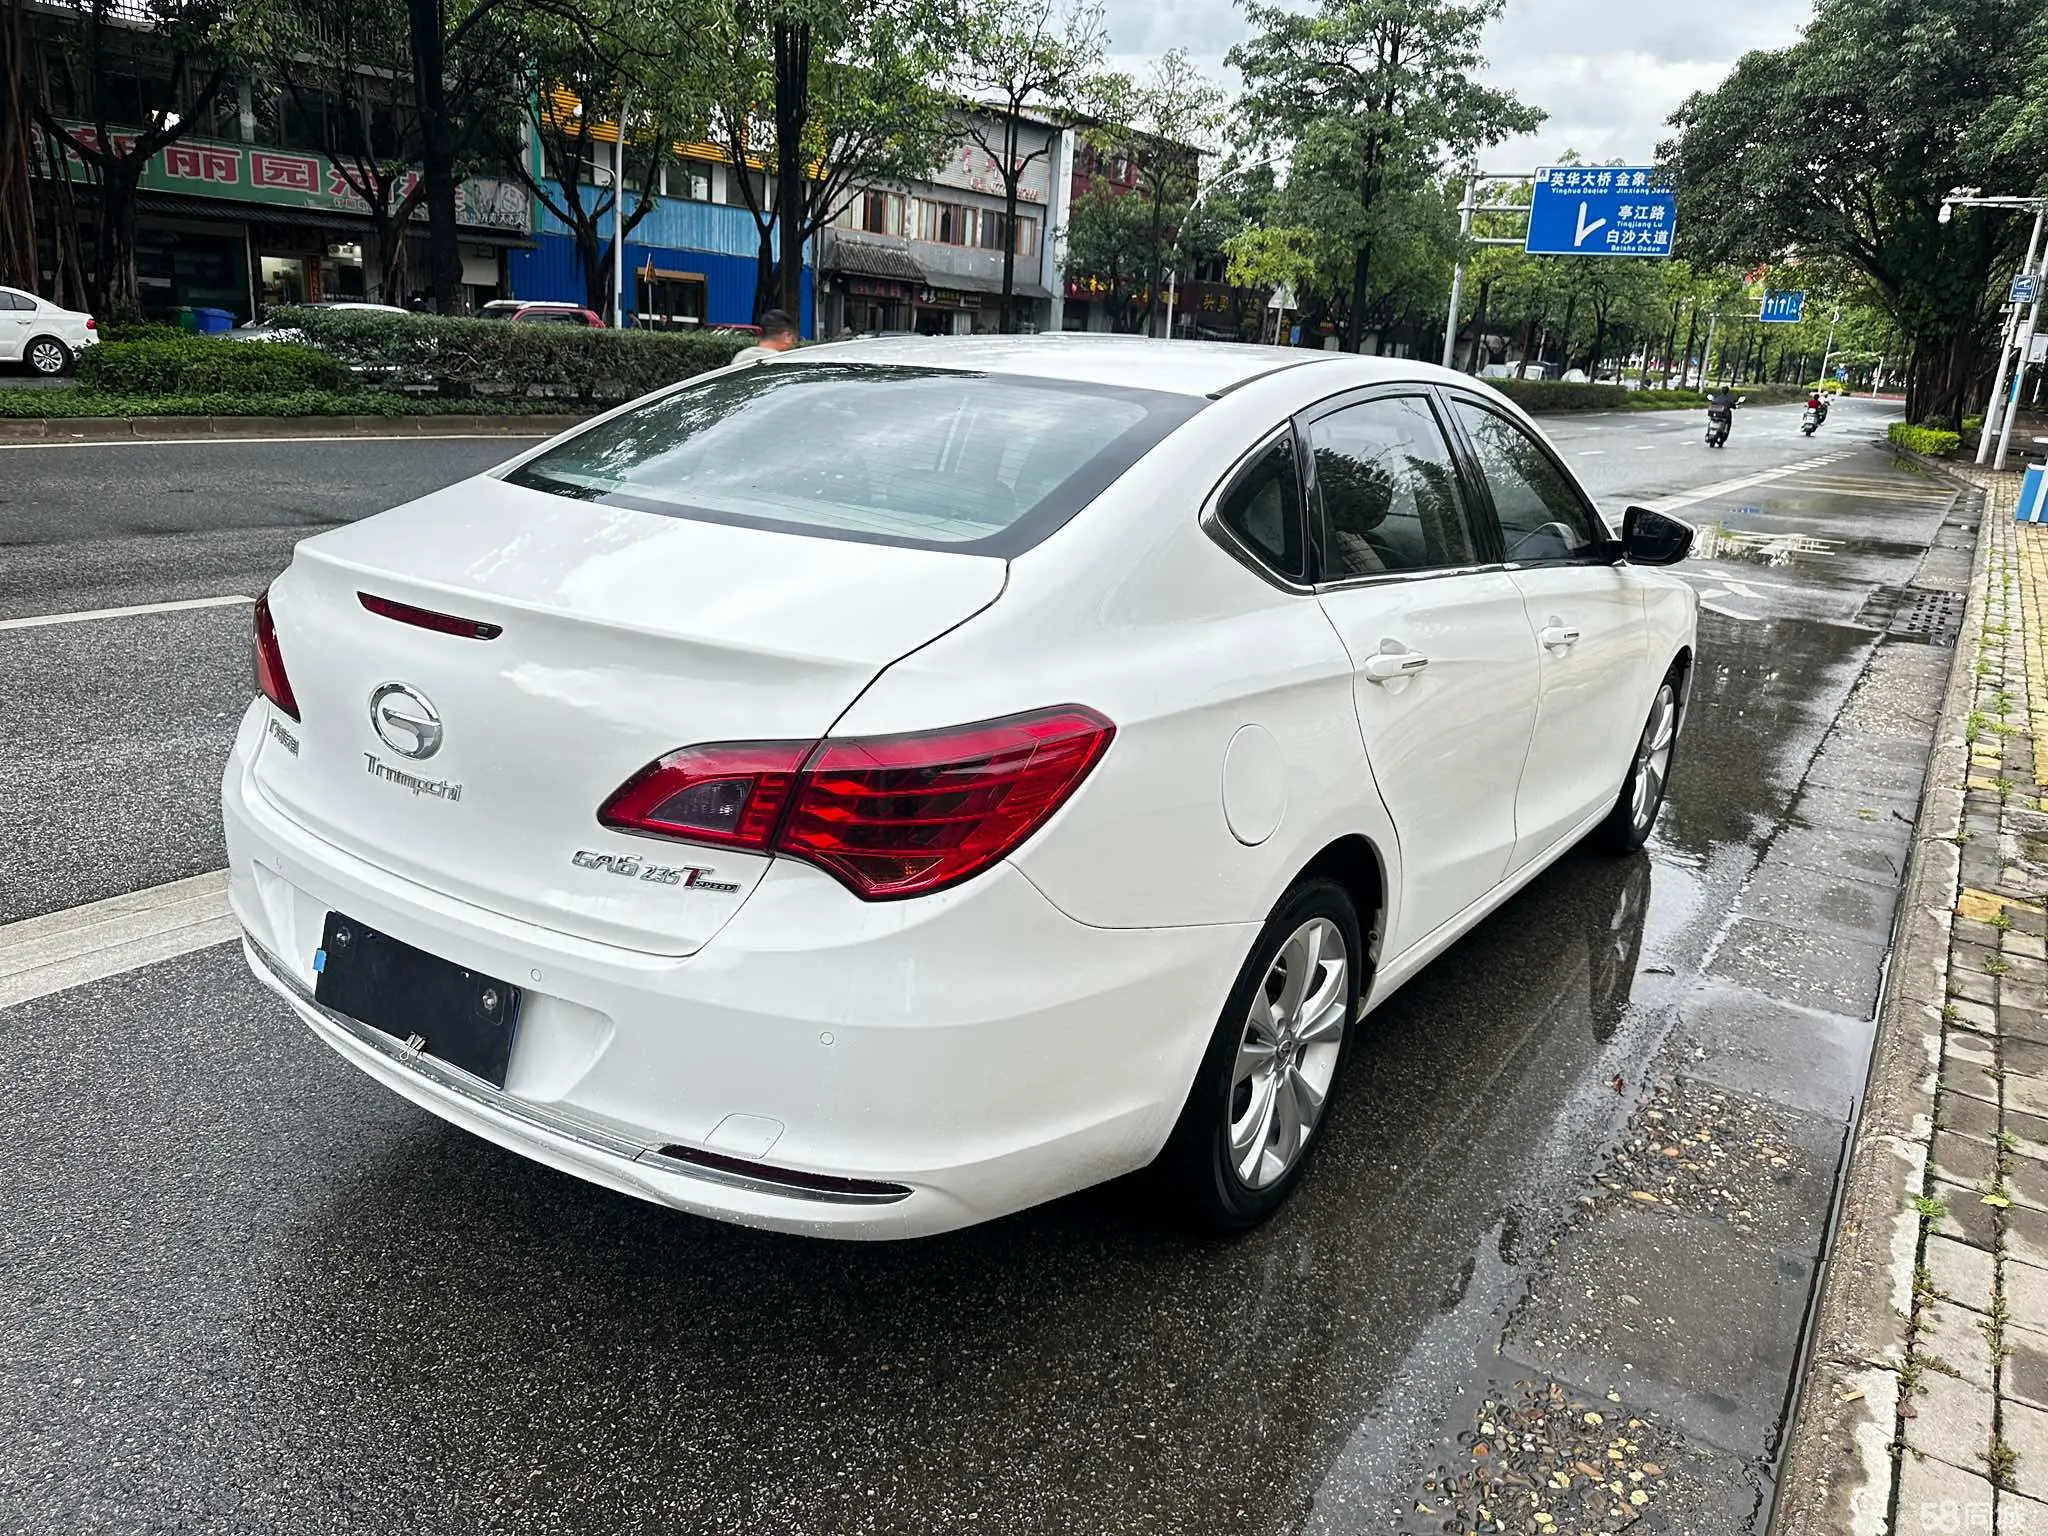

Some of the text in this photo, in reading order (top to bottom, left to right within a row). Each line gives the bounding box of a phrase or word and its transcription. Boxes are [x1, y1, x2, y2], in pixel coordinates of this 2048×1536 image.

[1550, 171, 1612, 187] 英华大桥
[1616, 171, 1677, 187] 金象
[1616, 187, 1649, 196] Jinxiang
[1618, 205, 1665, 220] 亭江路
[1617, 220, 1652, 228] Tingjiang
[1606, 229, 1669, 245] 白沙大道
[571, 849, 643, 877] GA6
